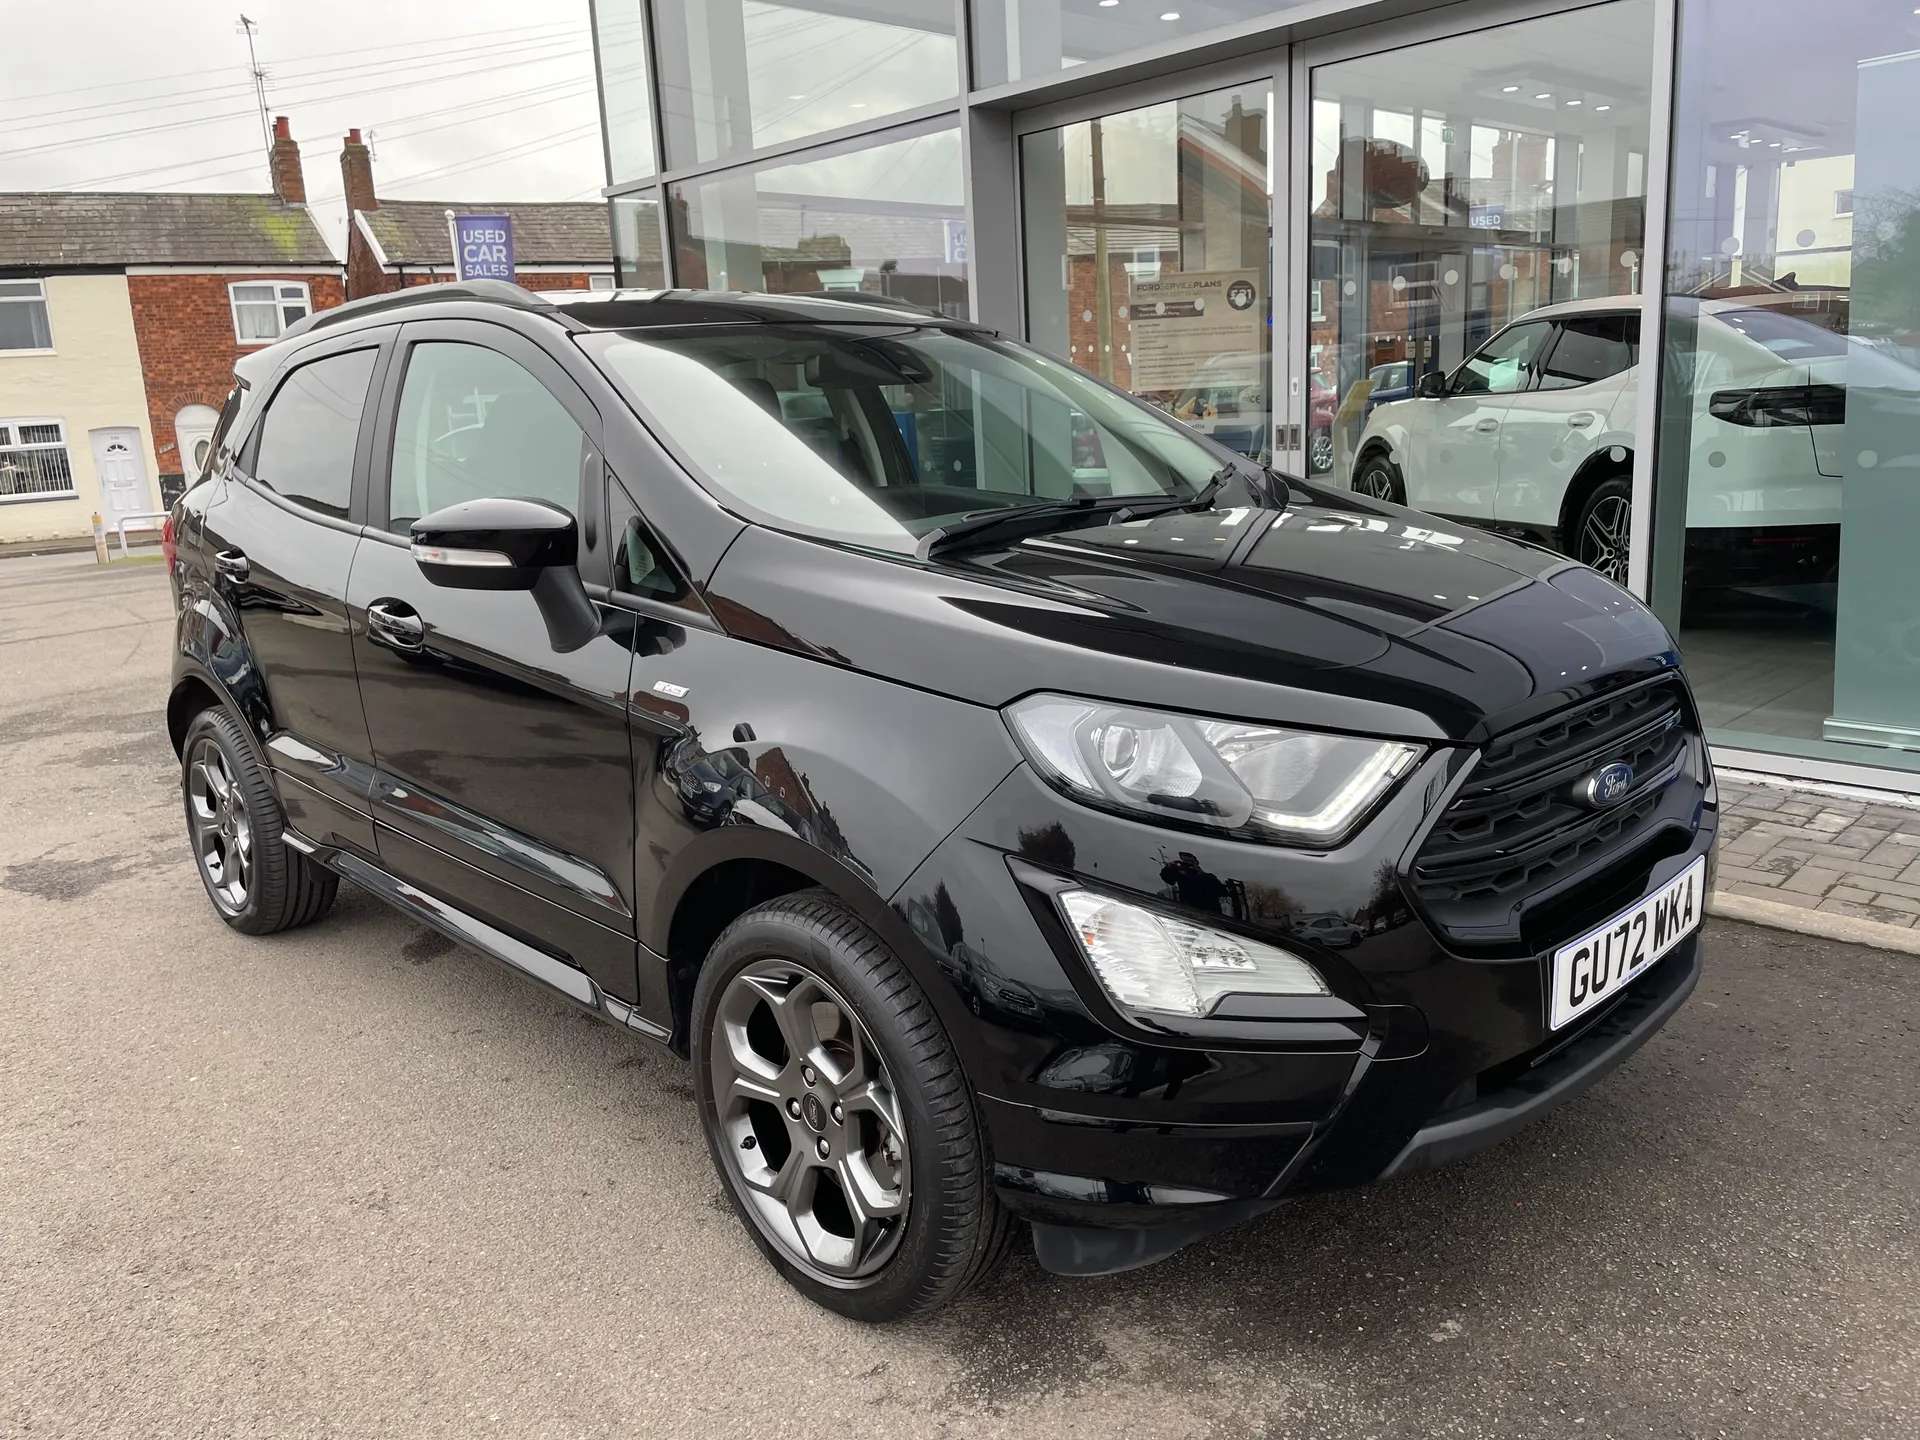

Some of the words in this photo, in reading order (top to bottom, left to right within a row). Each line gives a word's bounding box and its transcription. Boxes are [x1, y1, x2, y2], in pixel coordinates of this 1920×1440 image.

[1471, 215, 1501, 226] USED
[463, 230, 506, 243] USED
[464, 244, 507, 263] CAR
[465, 264, 509, 277] SALES
[1604, 772, 1628, 798] Ford
[1569, 911, 1648, 1008] GU72
[1652, 875, 1694, 953] WKA
